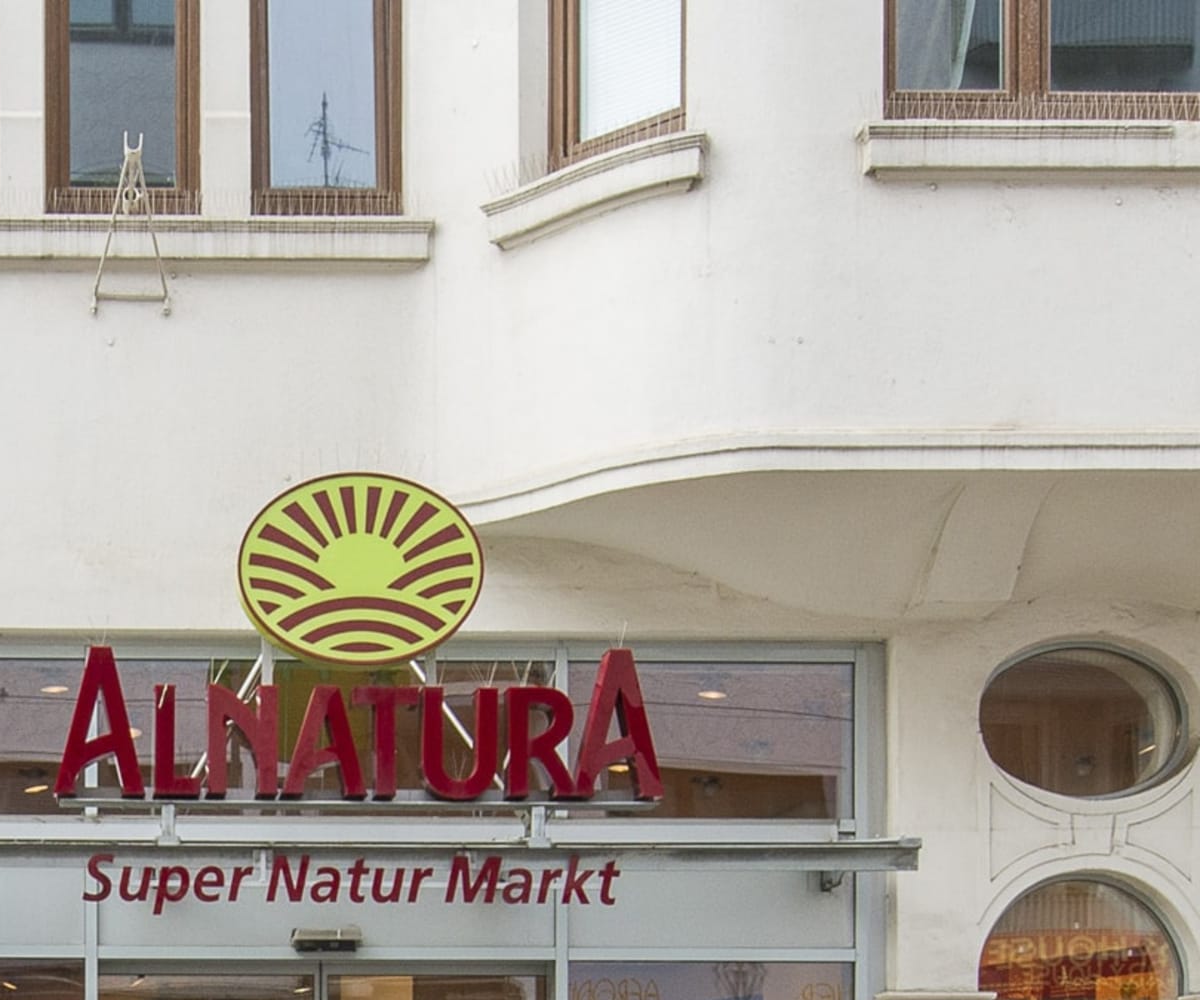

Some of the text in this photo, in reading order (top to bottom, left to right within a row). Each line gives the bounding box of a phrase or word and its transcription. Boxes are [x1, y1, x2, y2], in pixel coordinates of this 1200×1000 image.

[54, 645, 663, 802] ALNATURA
[82, 854, 622, 915] Super Natur Markt
